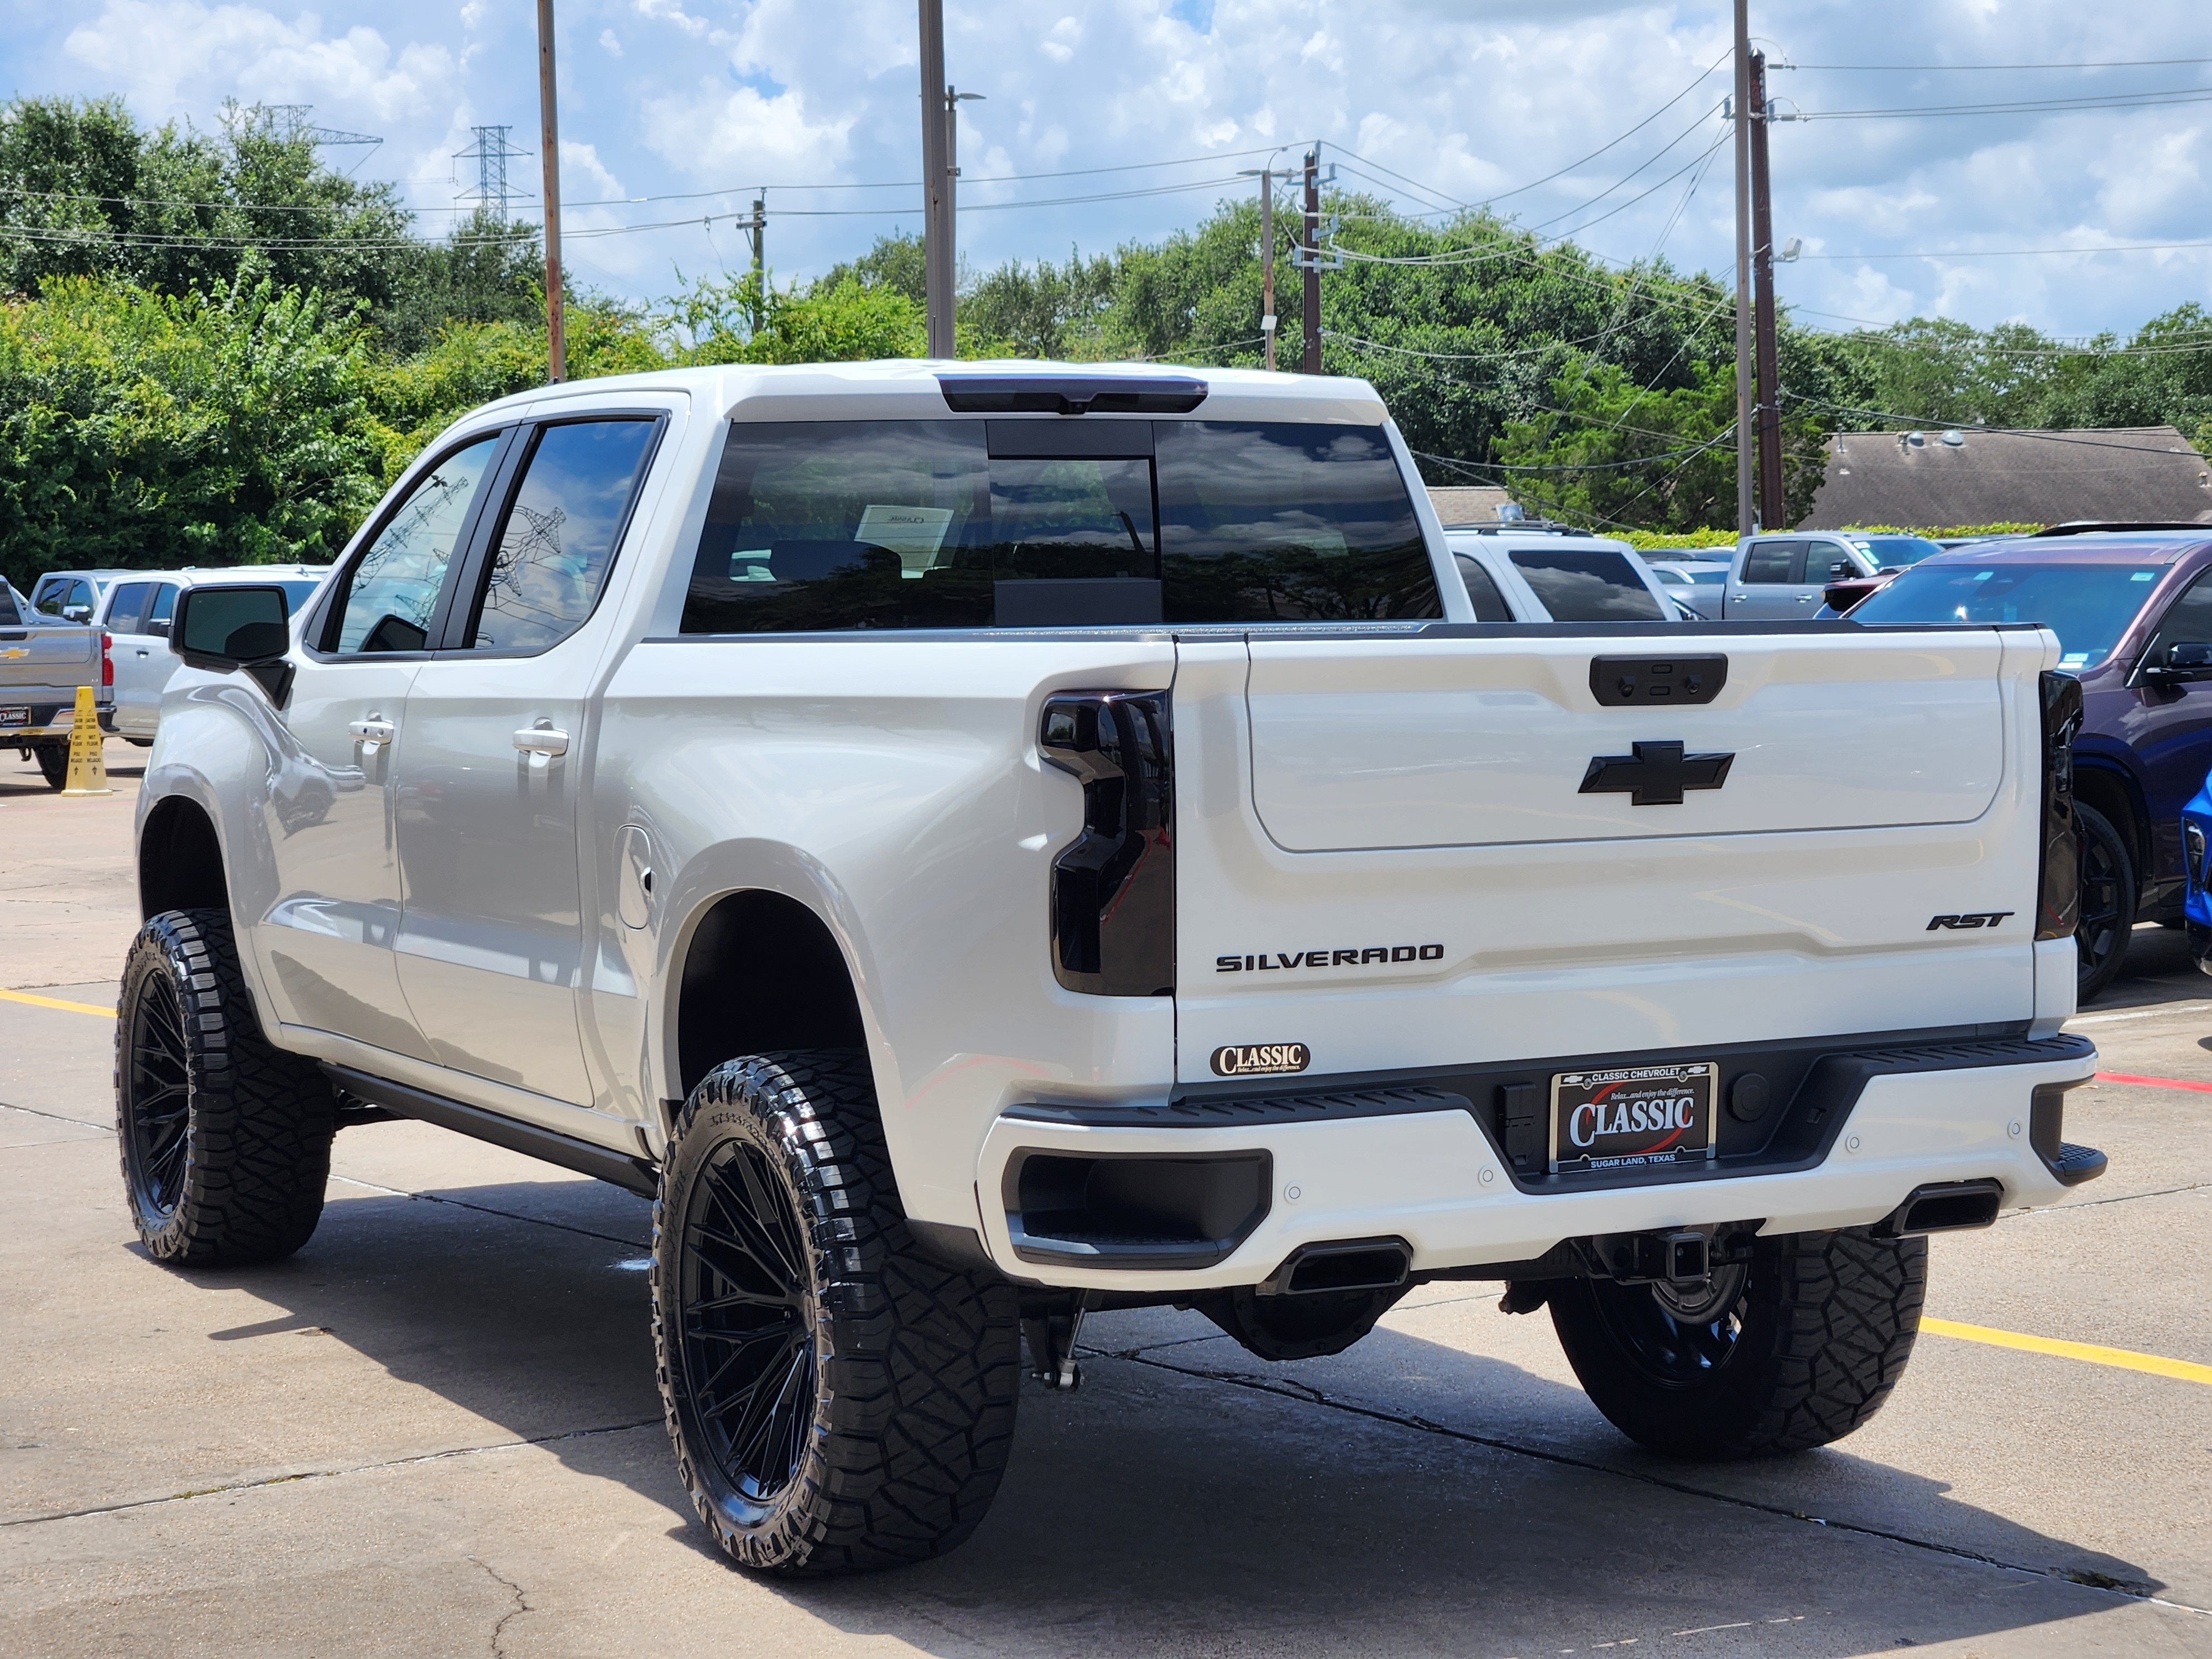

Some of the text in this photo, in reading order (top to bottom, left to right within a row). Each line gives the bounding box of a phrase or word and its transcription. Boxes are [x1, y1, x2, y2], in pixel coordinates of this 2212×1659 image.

[1926, 911, 2016, 931] RST
[1215, 943, 1444, 973] SILVERADO
[1219, 1045, 1302, 1074] CLASSIC
[1592, 1067, 1681, 1082] CLASSIC CHEVROLET
[1642, 1091, 1657, 1099] enjoy
[1666, 1088, 1694, 1098] difference.
[1569, 1097, 1694, 1147] CLASSIC
[1590, 1154, 1676, 1168] SUGAR LAND, TEXAS
